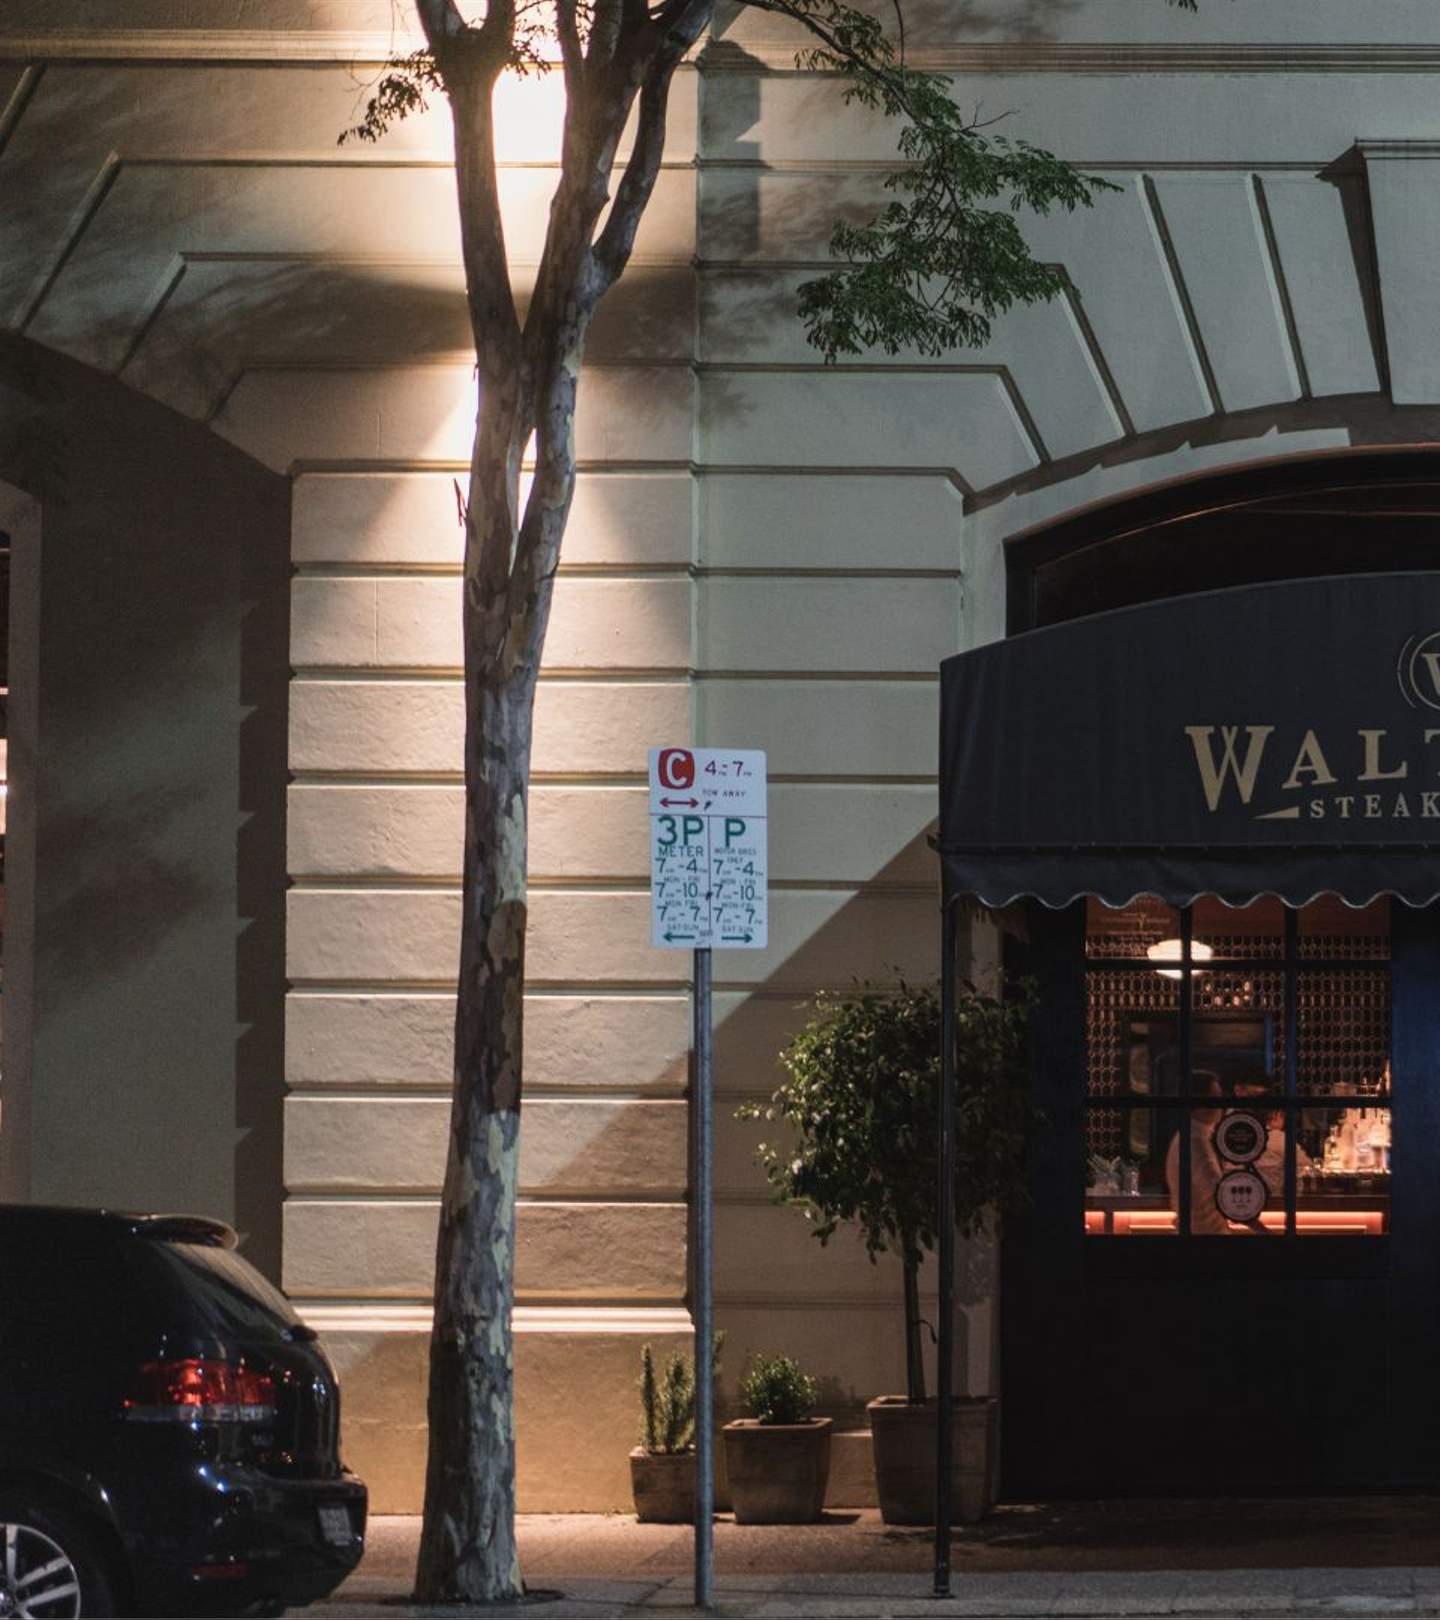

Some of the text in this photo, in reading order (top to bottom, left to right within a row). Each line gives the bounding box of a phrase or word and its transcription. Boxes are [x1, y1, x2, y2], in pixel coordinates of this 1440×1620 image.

[666, 752, 688, 787] C
[657, 814, 704, 846] 3P
[725, 817, 746, 848] P
[658, 845, 704, 857] METER
